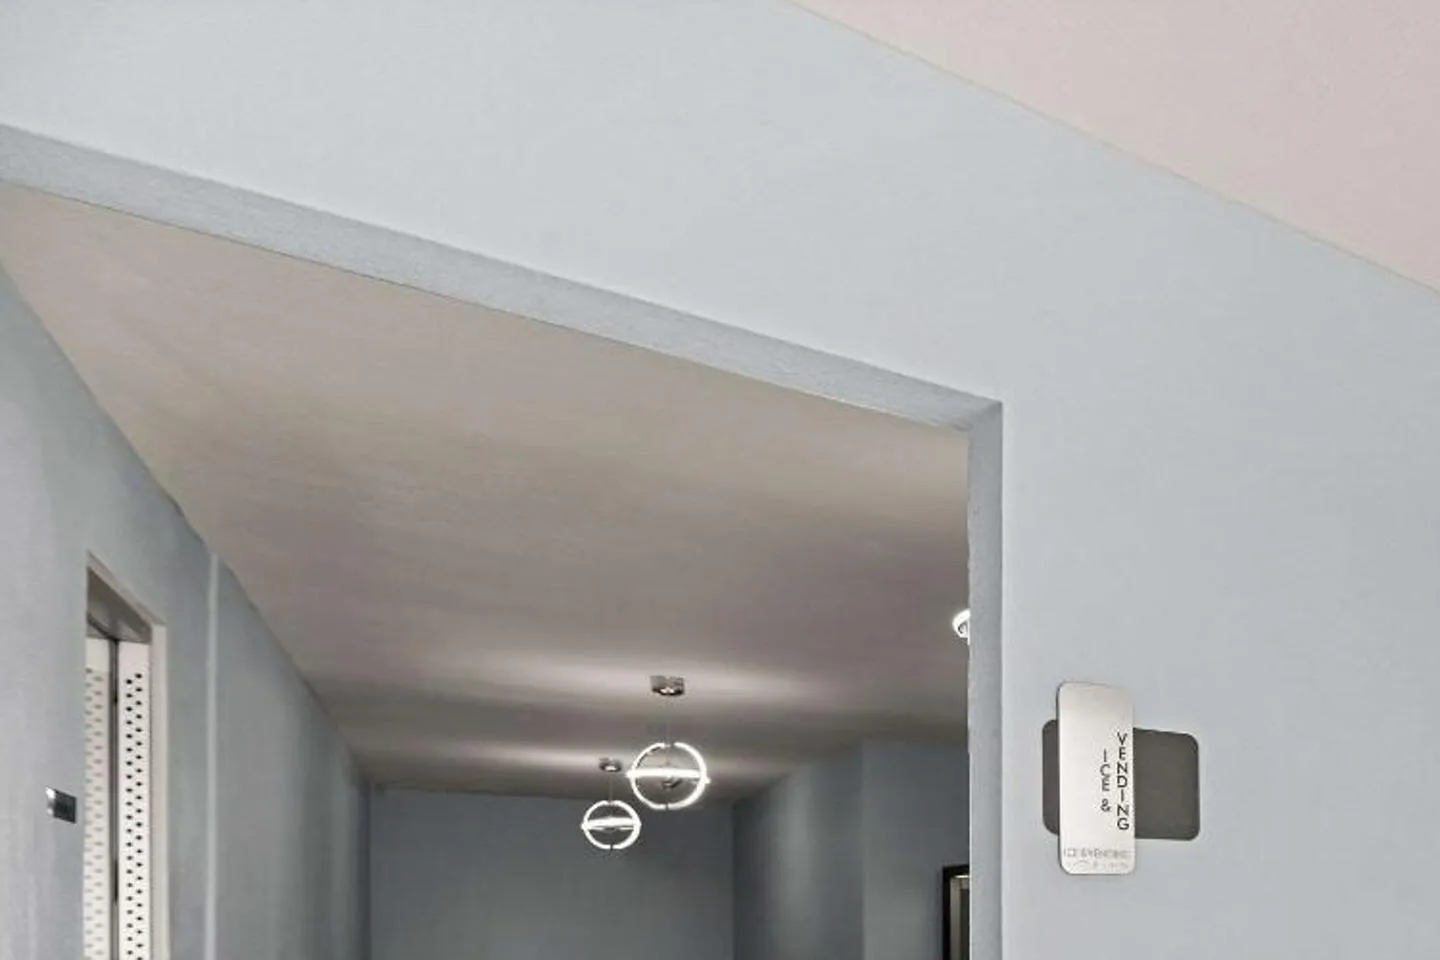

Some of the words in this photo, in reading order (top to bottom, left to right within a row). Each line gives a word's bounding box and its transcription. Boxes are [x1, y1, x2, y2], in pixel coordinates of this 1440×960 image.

[1100, 748, 1111, 792] ICE
[1117, 732, 1130, 830] VENDING
[1100, 797, 1111, 813] &
